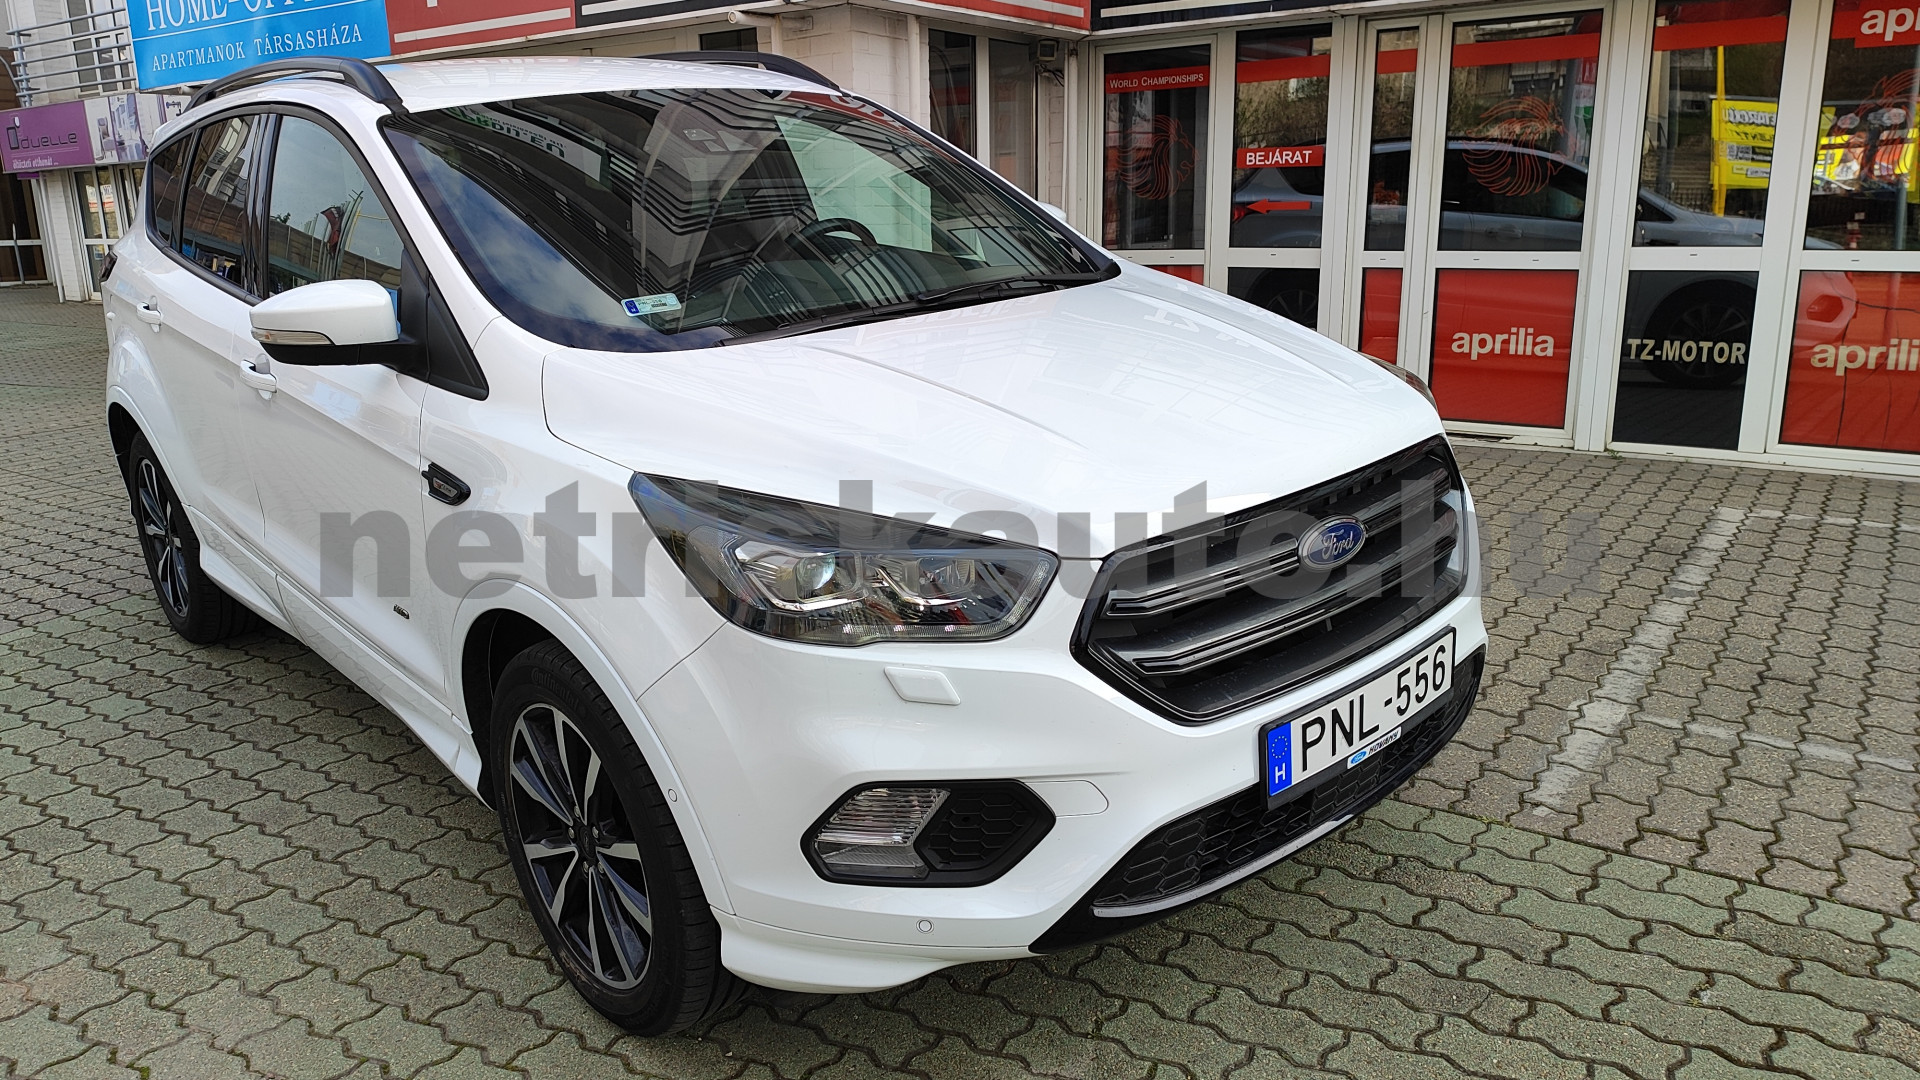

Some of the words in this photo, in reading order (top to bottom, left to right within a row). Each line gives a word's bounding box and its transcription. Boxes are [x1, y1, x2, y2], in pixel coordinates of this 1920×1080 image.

[152, 41, 246, 72] APARTMANOK
[253, 22, 363, 56] TÁRSASHÁZA
[1245, 148, 1313, 166] BEJÁRAT
[1450, 327, 1555, 360] aprilia
[1627, 338, 1746, 365] TZ-MOTOR
[1810, 338, 1920, 377] aprili
[1322, 529, 1355, 559] Ford
[1275, 763, 1286, 785] H
